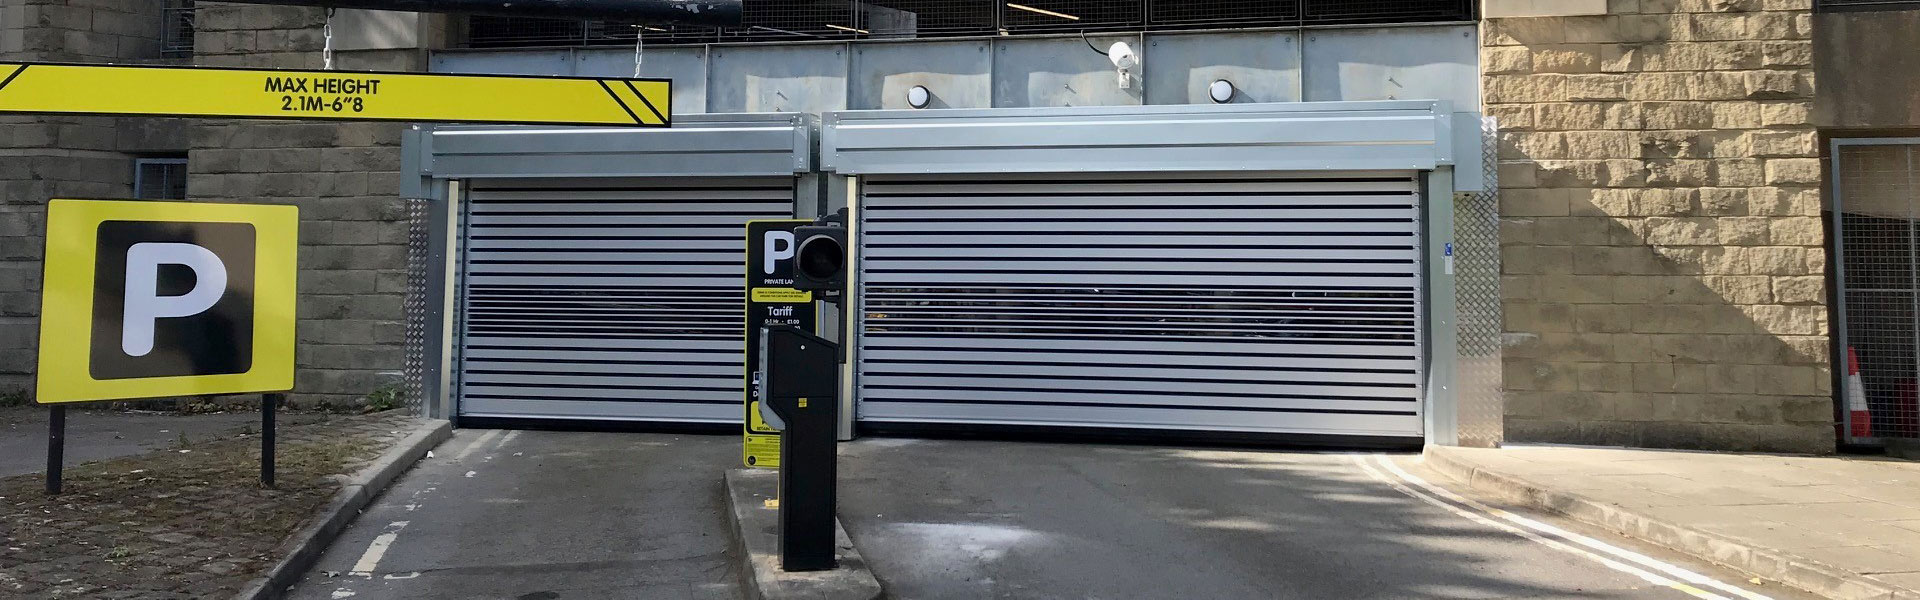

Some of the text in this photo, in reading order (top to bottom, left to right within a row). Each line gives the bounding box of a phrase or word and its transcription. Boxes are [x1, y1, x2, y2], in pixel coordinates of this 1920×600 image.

[264, 77, 380, 94] MAX HEIGHT
[764, 230, 795, 274] P
[122, 242, 228, 357] P
[767, 306, 793, 317] Tariff
